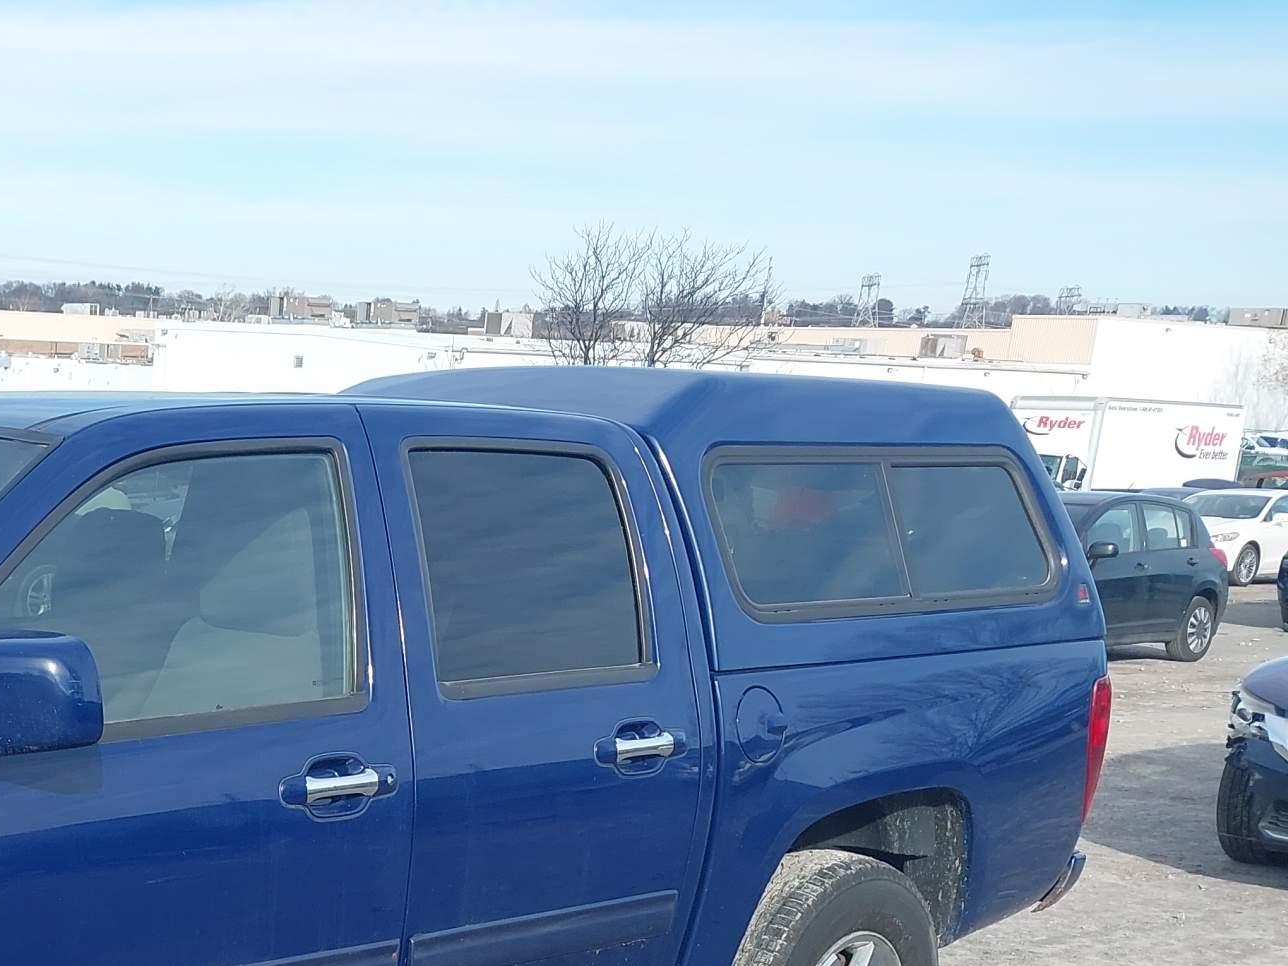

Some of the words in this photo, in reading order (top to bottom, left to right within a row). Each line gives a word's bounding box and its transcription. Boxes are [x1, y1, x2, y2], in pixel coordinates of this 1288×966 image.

[1036, 416, 1086, 431] Ryder
[1186, 425, 1228, 451] Ryder
[1198, 449, 1212, 460] Ever
